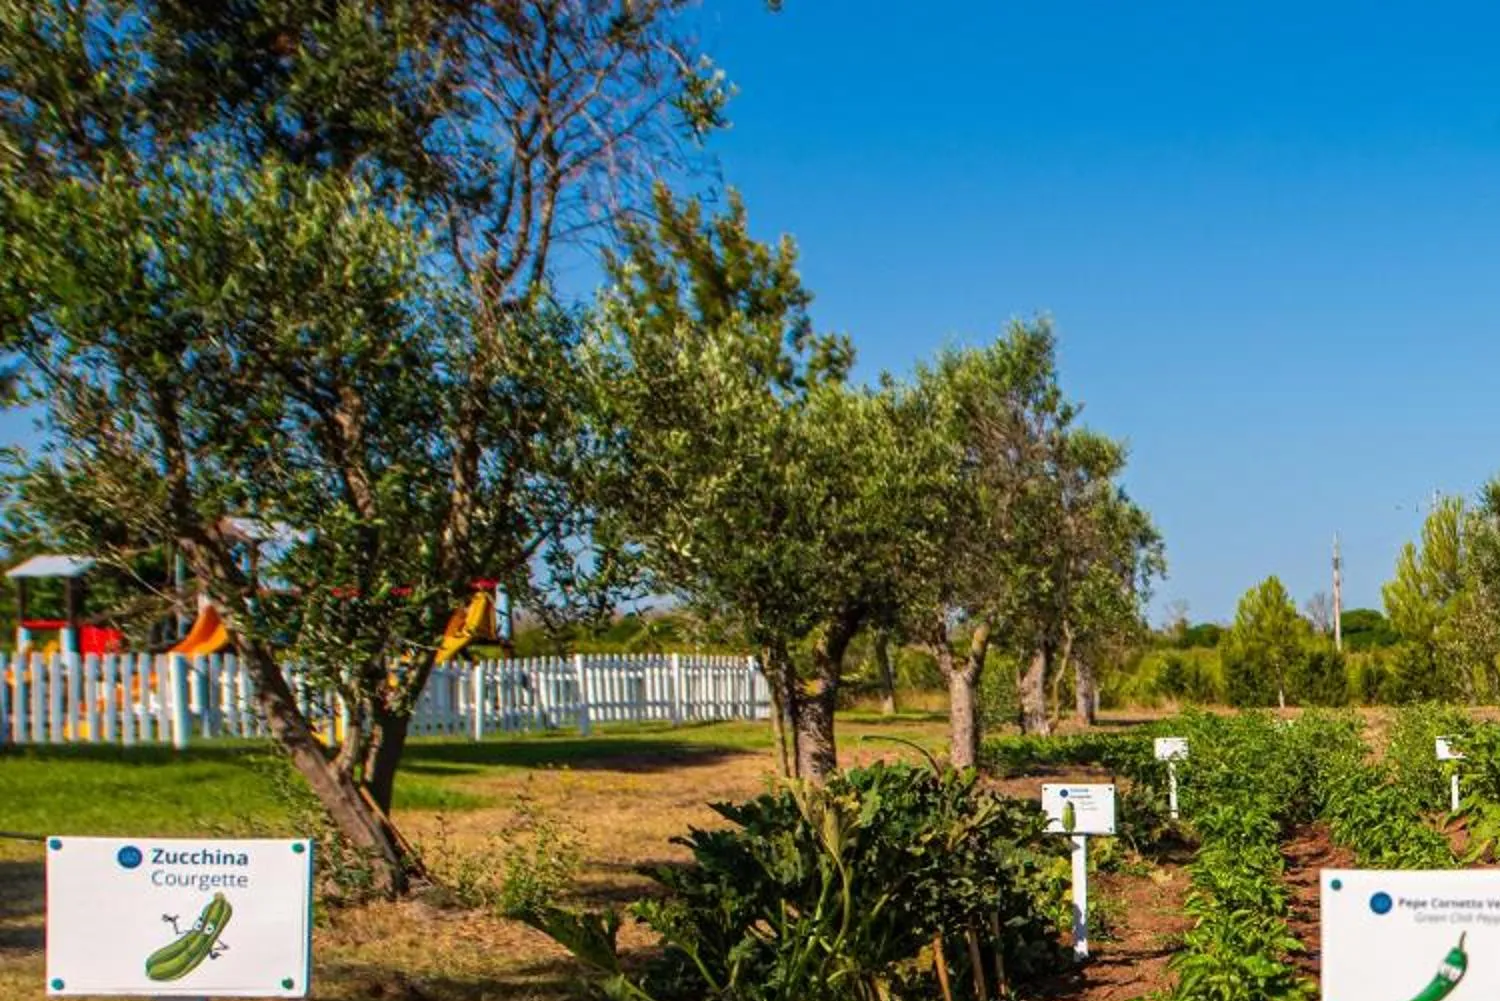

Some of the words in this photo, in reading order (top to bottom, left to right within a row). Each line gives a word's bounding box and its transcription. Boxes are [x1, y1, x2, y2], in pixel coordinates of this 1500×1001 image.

[151, 847, 249, 866] Zucchina
[151, 869, 249, 891] Courgette
[1398, 897, 1427, 911] Pepe
[1413, 912, 1447, 924] Green
